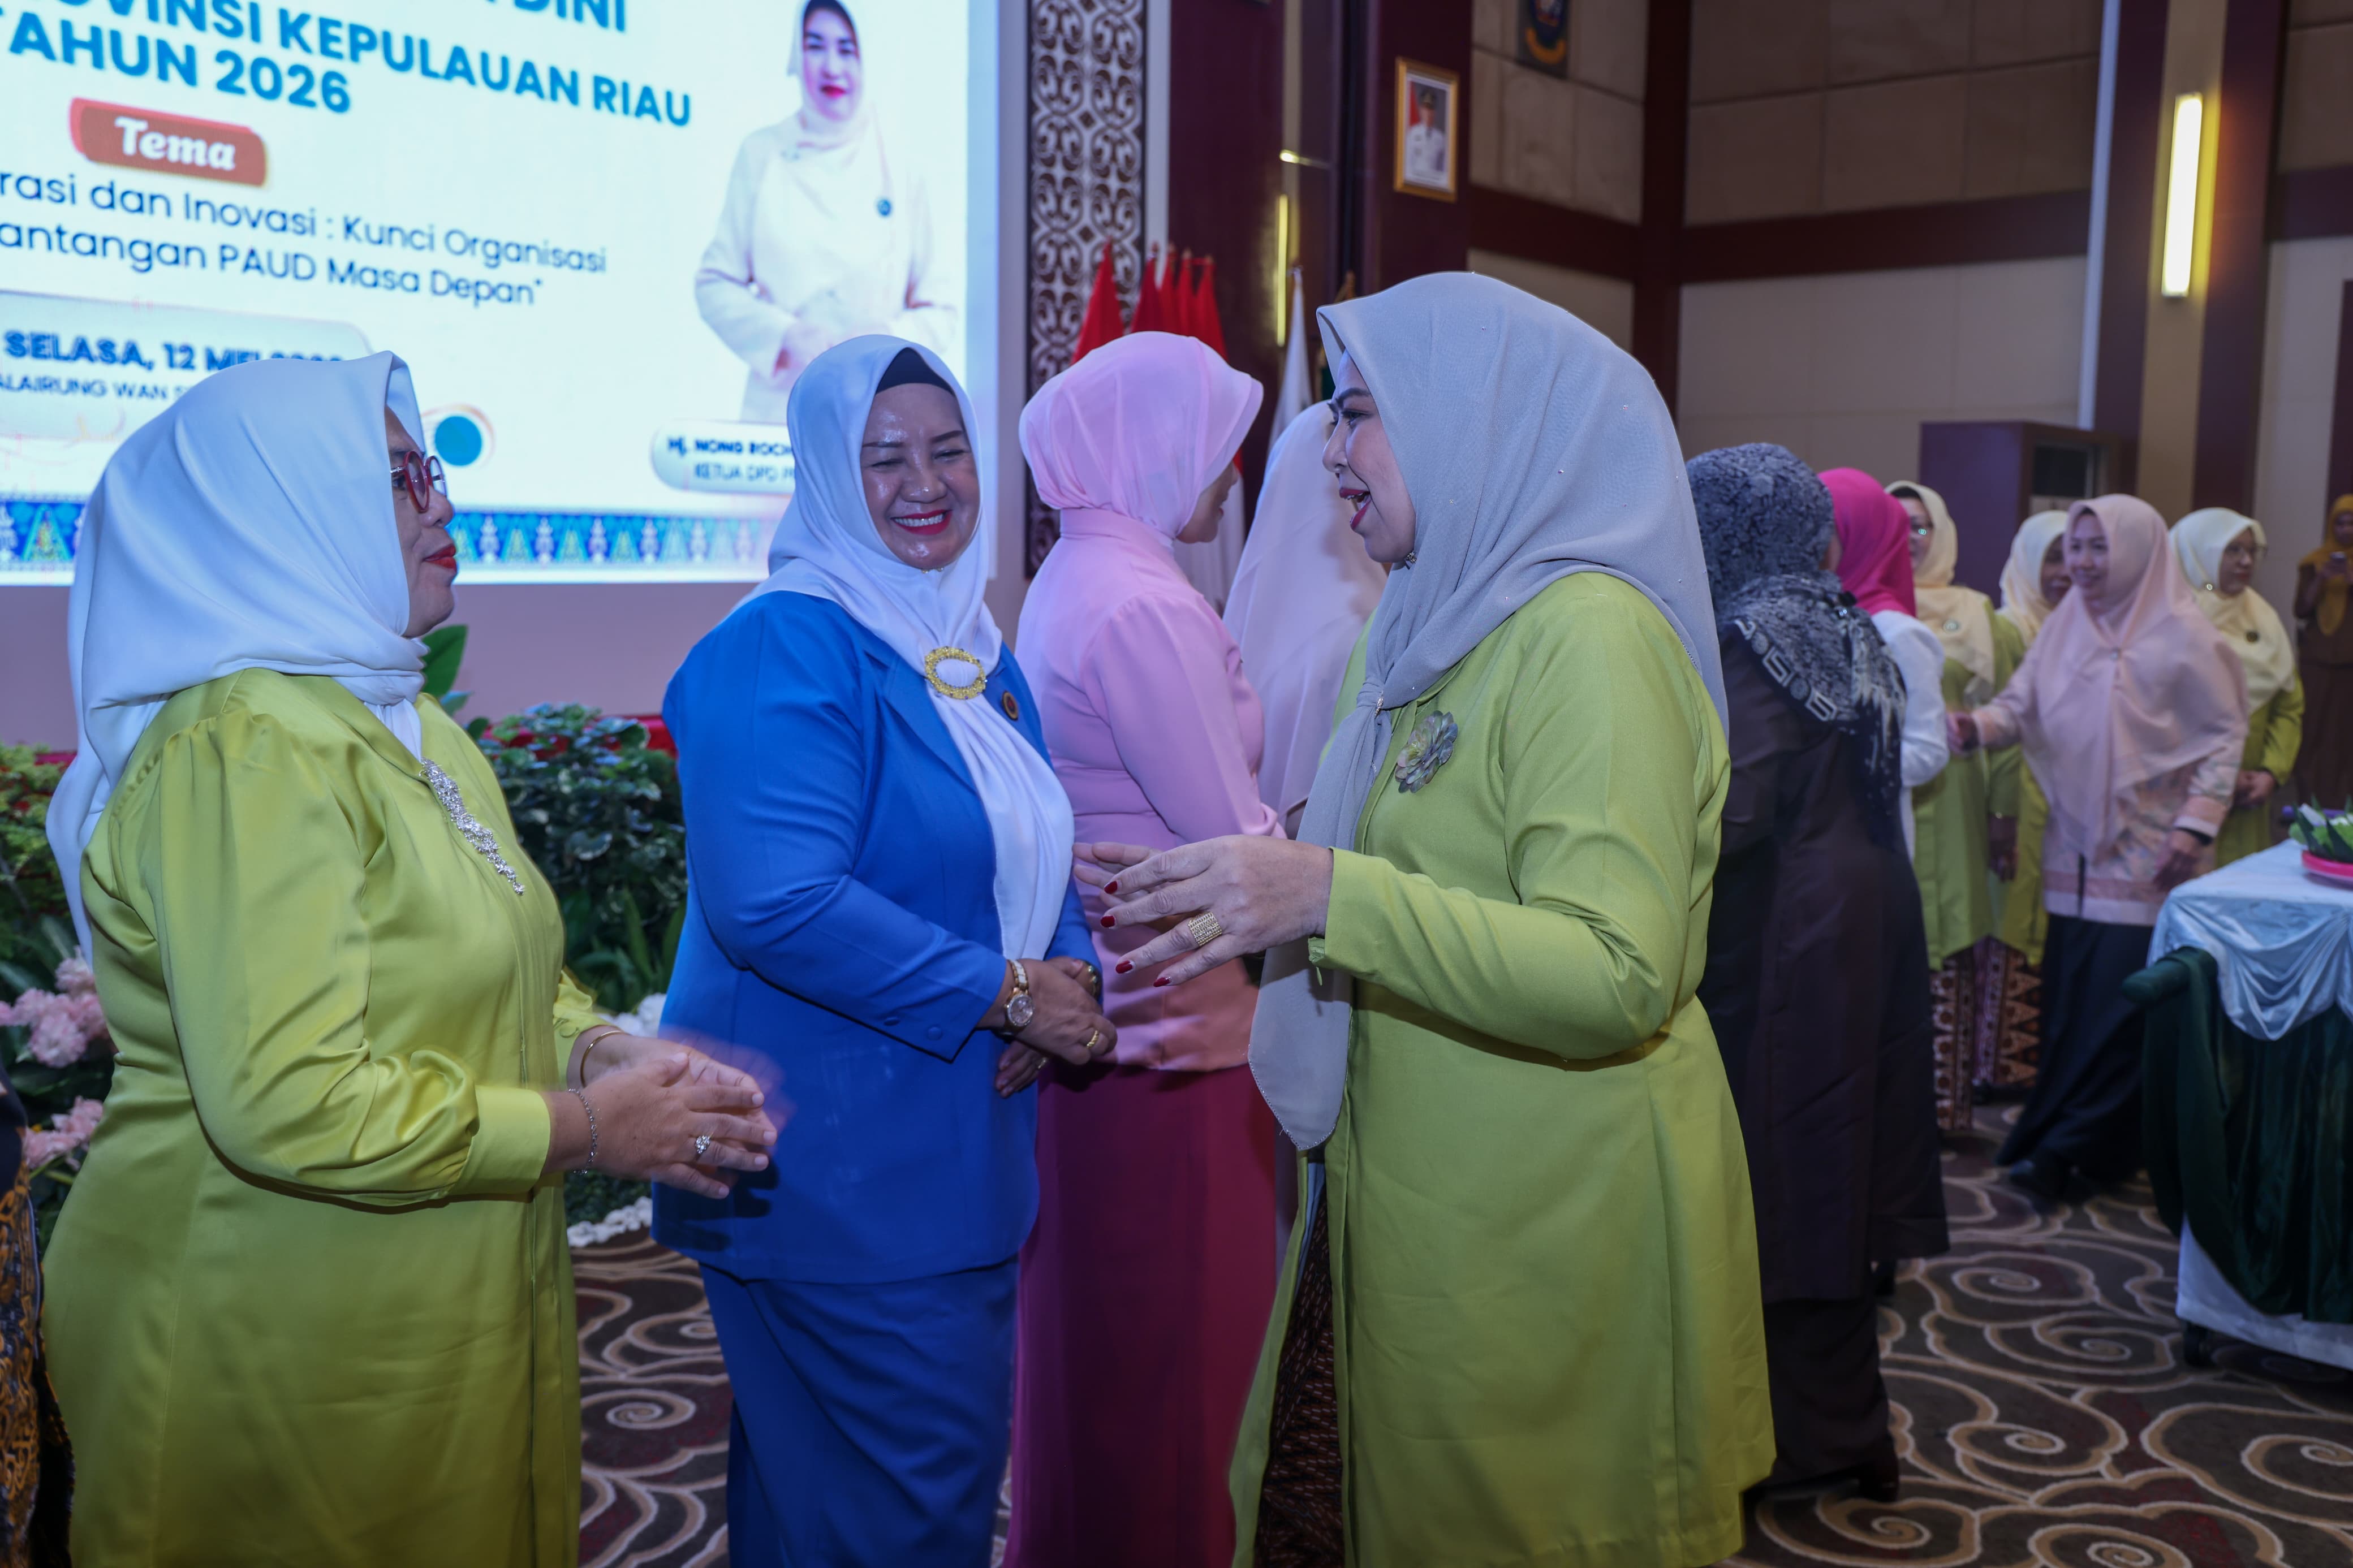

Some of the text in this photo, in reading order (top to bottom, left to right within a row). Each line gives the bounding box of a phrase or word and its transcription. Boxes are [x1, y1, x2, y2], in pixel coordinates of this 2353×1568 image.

[0, 6, 351, 114] AHUN 2026
[279, 8, 579, 106] KEPULAUAN
[593, 75, 690, 127] RIAU
[114, 116, 236, 170] Tema
[90, 179, 172, 218] dan
[184, 192, 317, 237] Inovasi
[343, 215, 435, 253] Kunci
[444, 228, 607, 274] Organisasi
[219, 244, 317, 282] PAUD
[327, 257, 420, 293] Masa
[5, 330, 154, 371] SELASA,
[162, 342, 196, 371] 12
